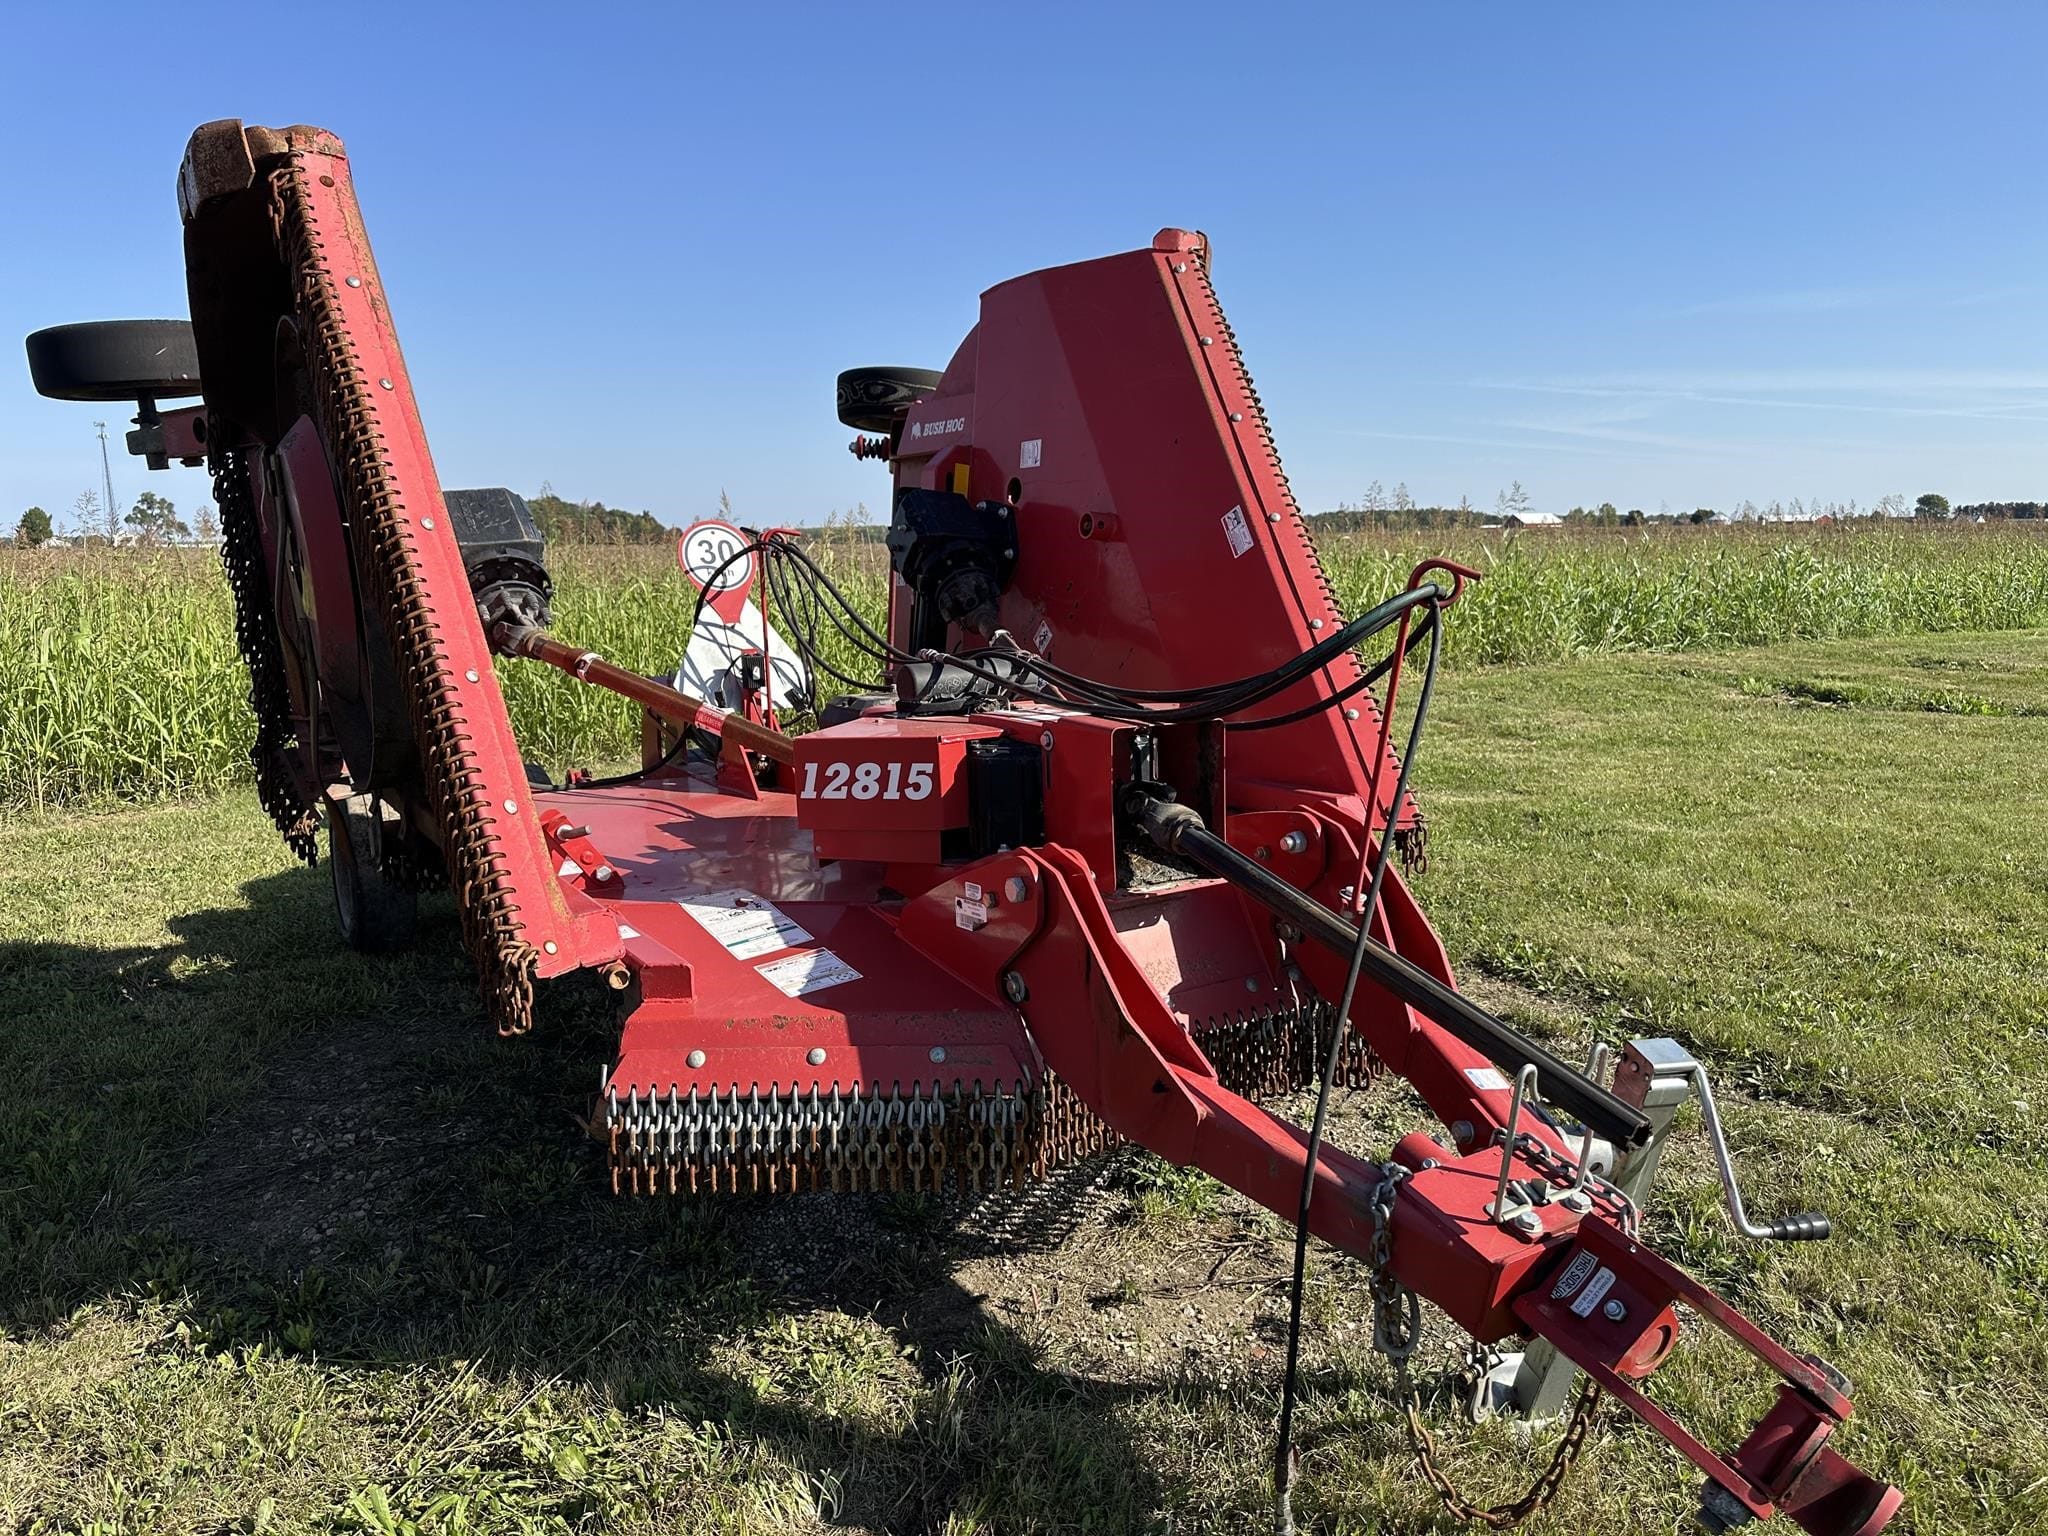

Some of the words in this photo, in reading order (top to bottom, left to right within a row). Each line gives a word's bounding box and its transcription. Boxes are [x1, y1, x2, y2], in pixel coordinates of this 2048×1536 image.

[923, 420, 945, 436] BUSH
[945, 417, 965, 433] HOG
[698, 540, 734, 564] 30
[800, 762, 934, 800] 12815
[1575, 1254, 1593, 1274] THIS
[1562, 1271, 1581, 1290] SIDE
[1553, 1285, 1567, 1298] UP
